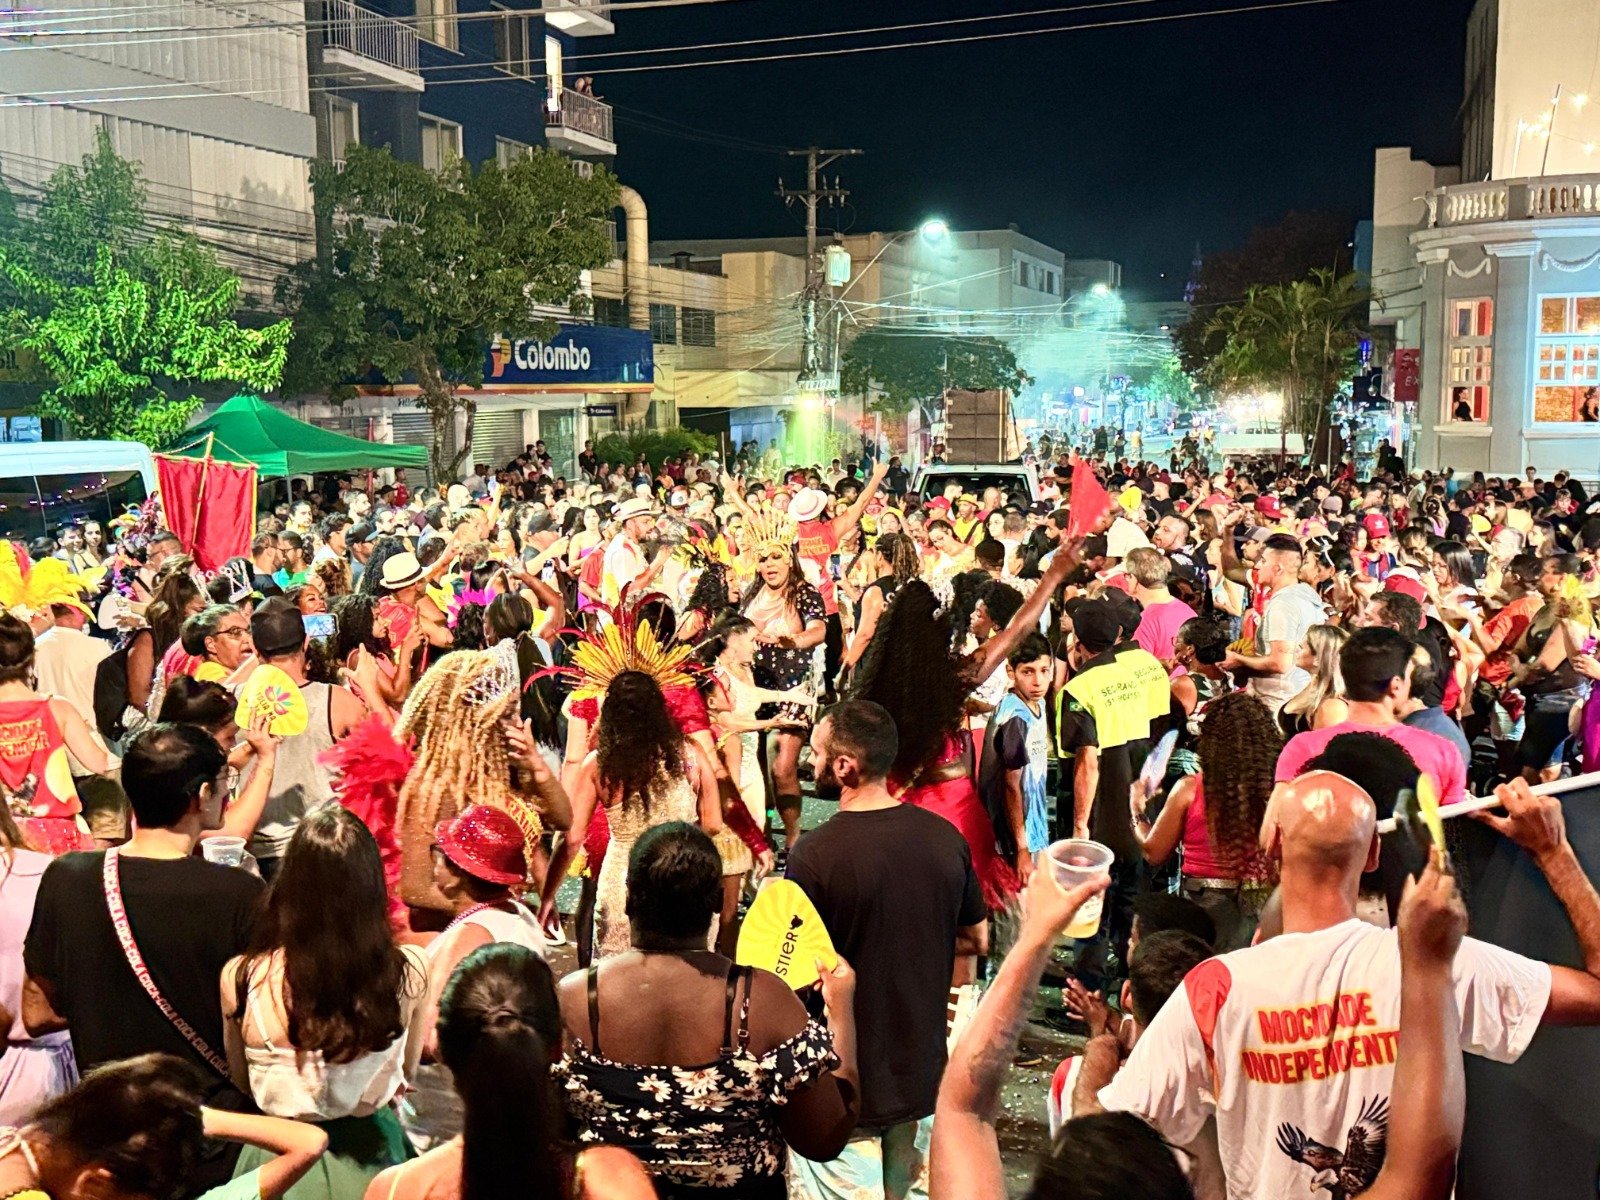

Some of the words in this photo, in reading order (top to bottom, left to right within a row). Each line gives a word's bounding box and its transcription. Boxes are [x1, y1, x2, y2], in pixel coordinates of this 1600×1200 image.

[514, 339, 591, 371] Colombo
[114, 919, 149, 977] COCA-COLA
[139, 973, 178, 1020] COCA-COLA
[173, 1017, 215, 1060] COCA-COLA
[1257, 992, 1377, 1044] MOCIDADE
